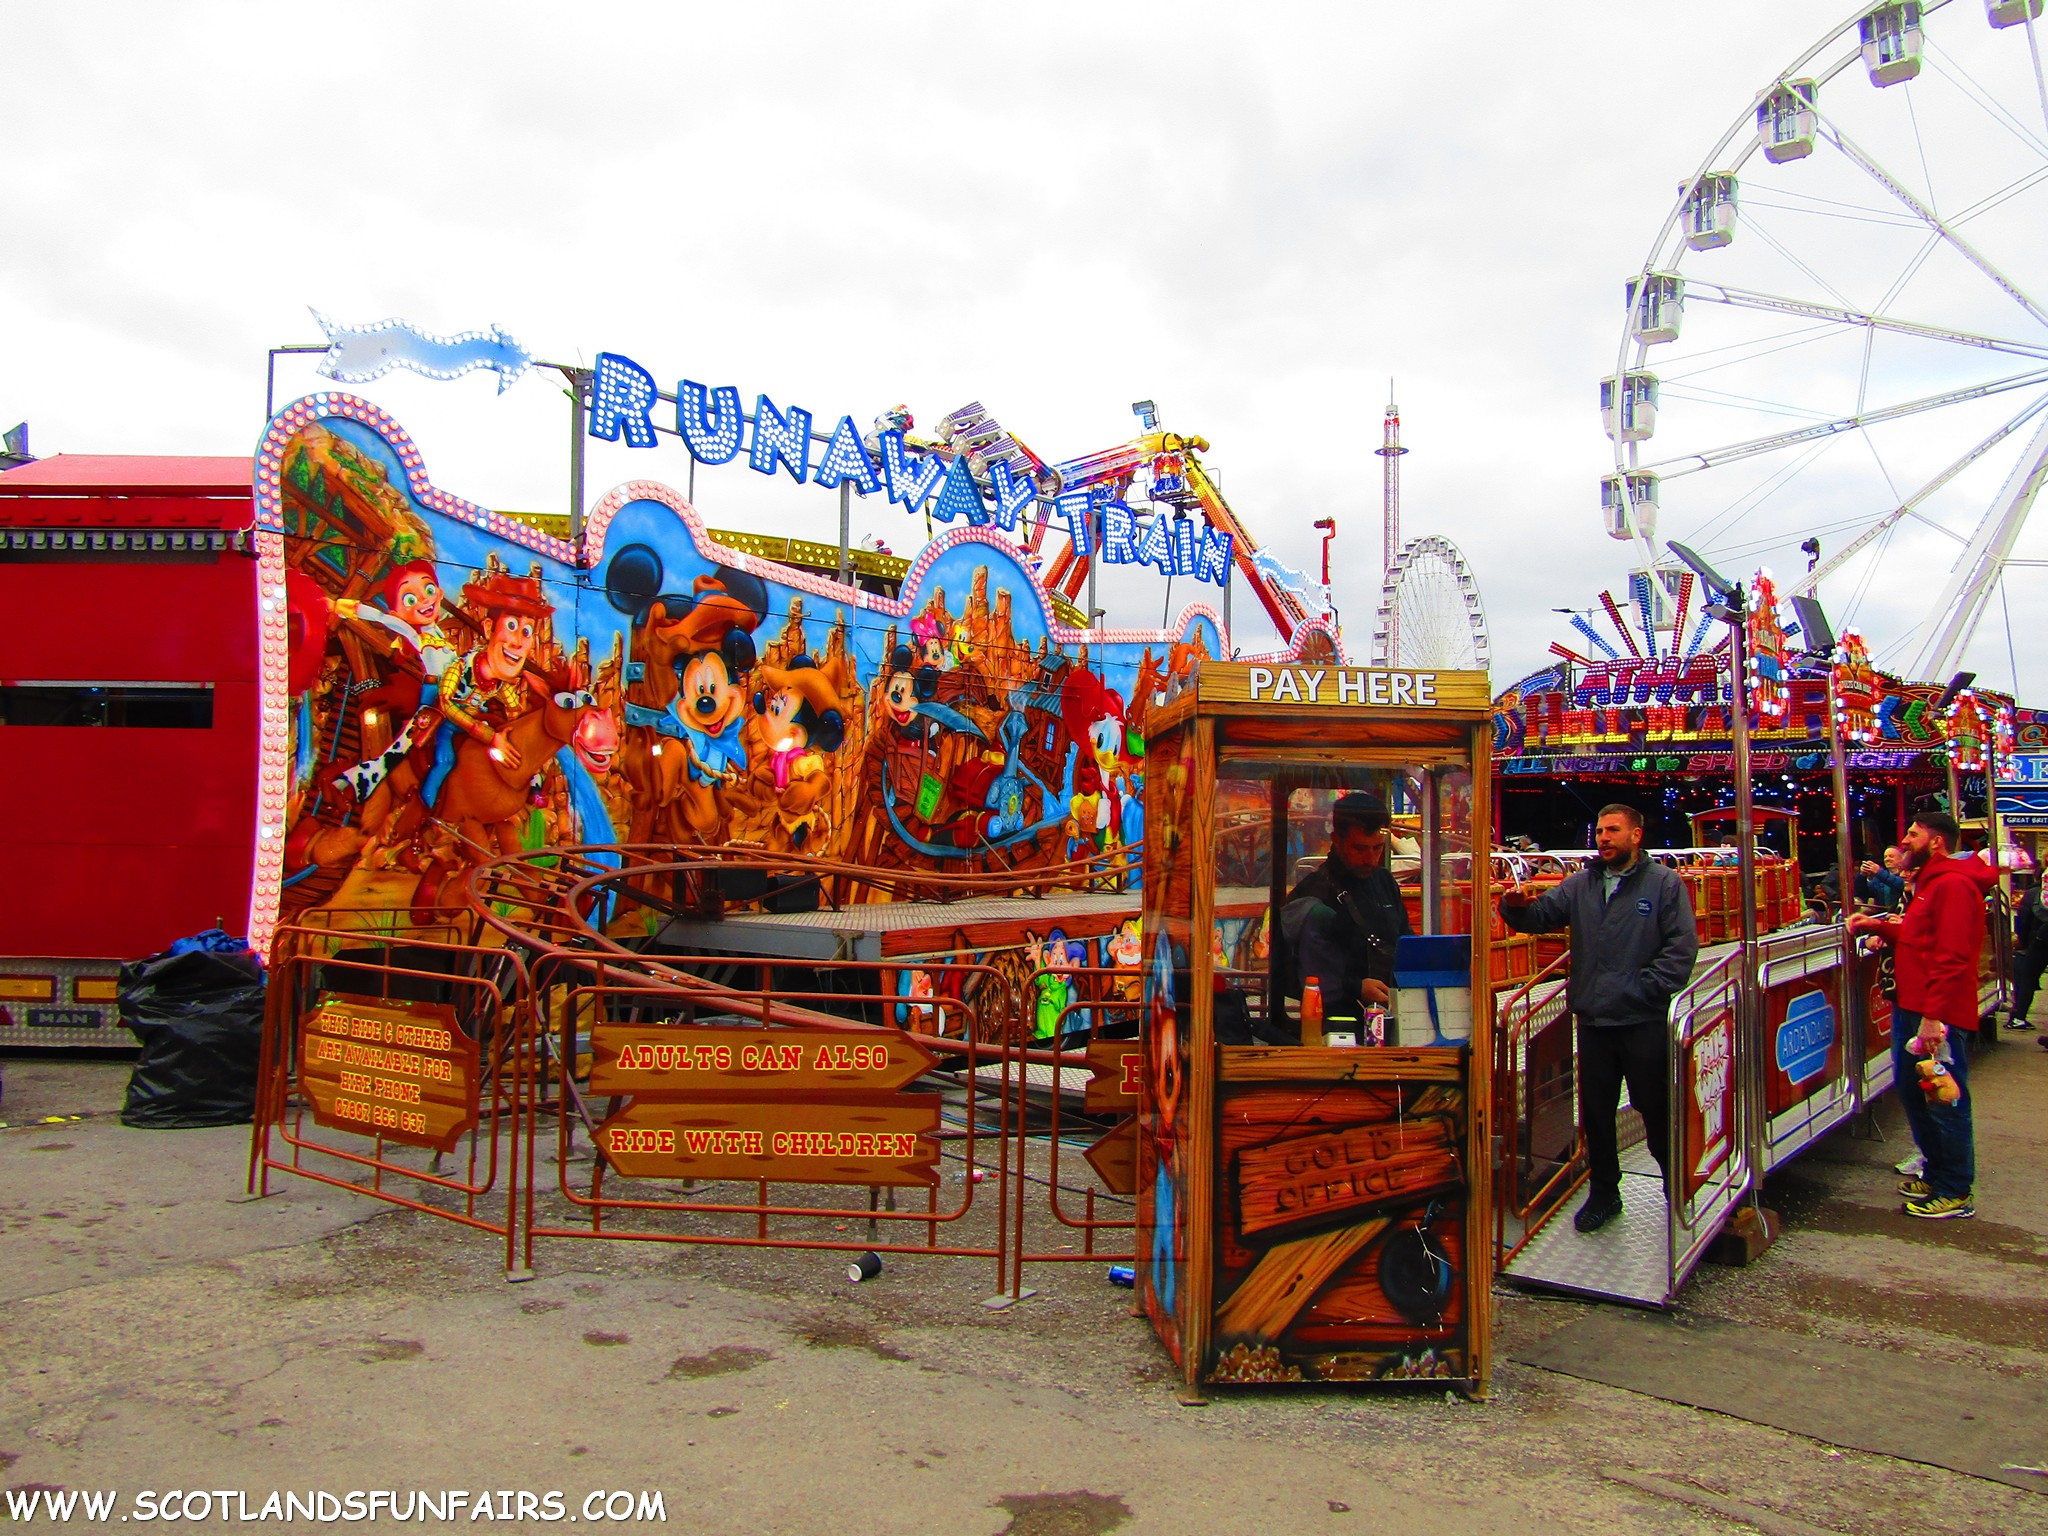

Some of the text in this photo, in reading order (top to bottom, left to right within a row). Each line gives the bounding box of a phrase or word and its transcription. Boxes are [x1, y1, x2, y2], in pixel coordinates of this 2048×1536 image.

[589, 351, 1234, 588] RUNAWAY TRAIN
[1248, 667, 1438, 707] PAY HERE
[1503, 758, 1548, 775] ALL
[1552, 755, 1626, 774] NIGHT
[1631, 757, 1648, 772] at
[2006, 816, 2030, 824] GREAT
[38, 1013, 89, 1024] MAN
[320, 1012, 349, 1036] THIS
[351, 1017, 382, 1041] RIDE
[396, 1024, 452, 1051] OTHERS
[1783, 1014, 1832, 1060] ARDENDALE
[317, 1039, 452, 1082] ARE AVAILABLE FOR
[616, 1044, 889, 1071] ADULTS CAN ALSO
[340, 1070, 421, 1104] HIRE PHONE
[401, 1110, 426, 1135] 637
[609, 1128, 917, 1158] RIDE WITH CHILDREN
[1285, 1137, 1391, 1175] GOLD
[1275, 1166, 1406, 1212] OFFICE
